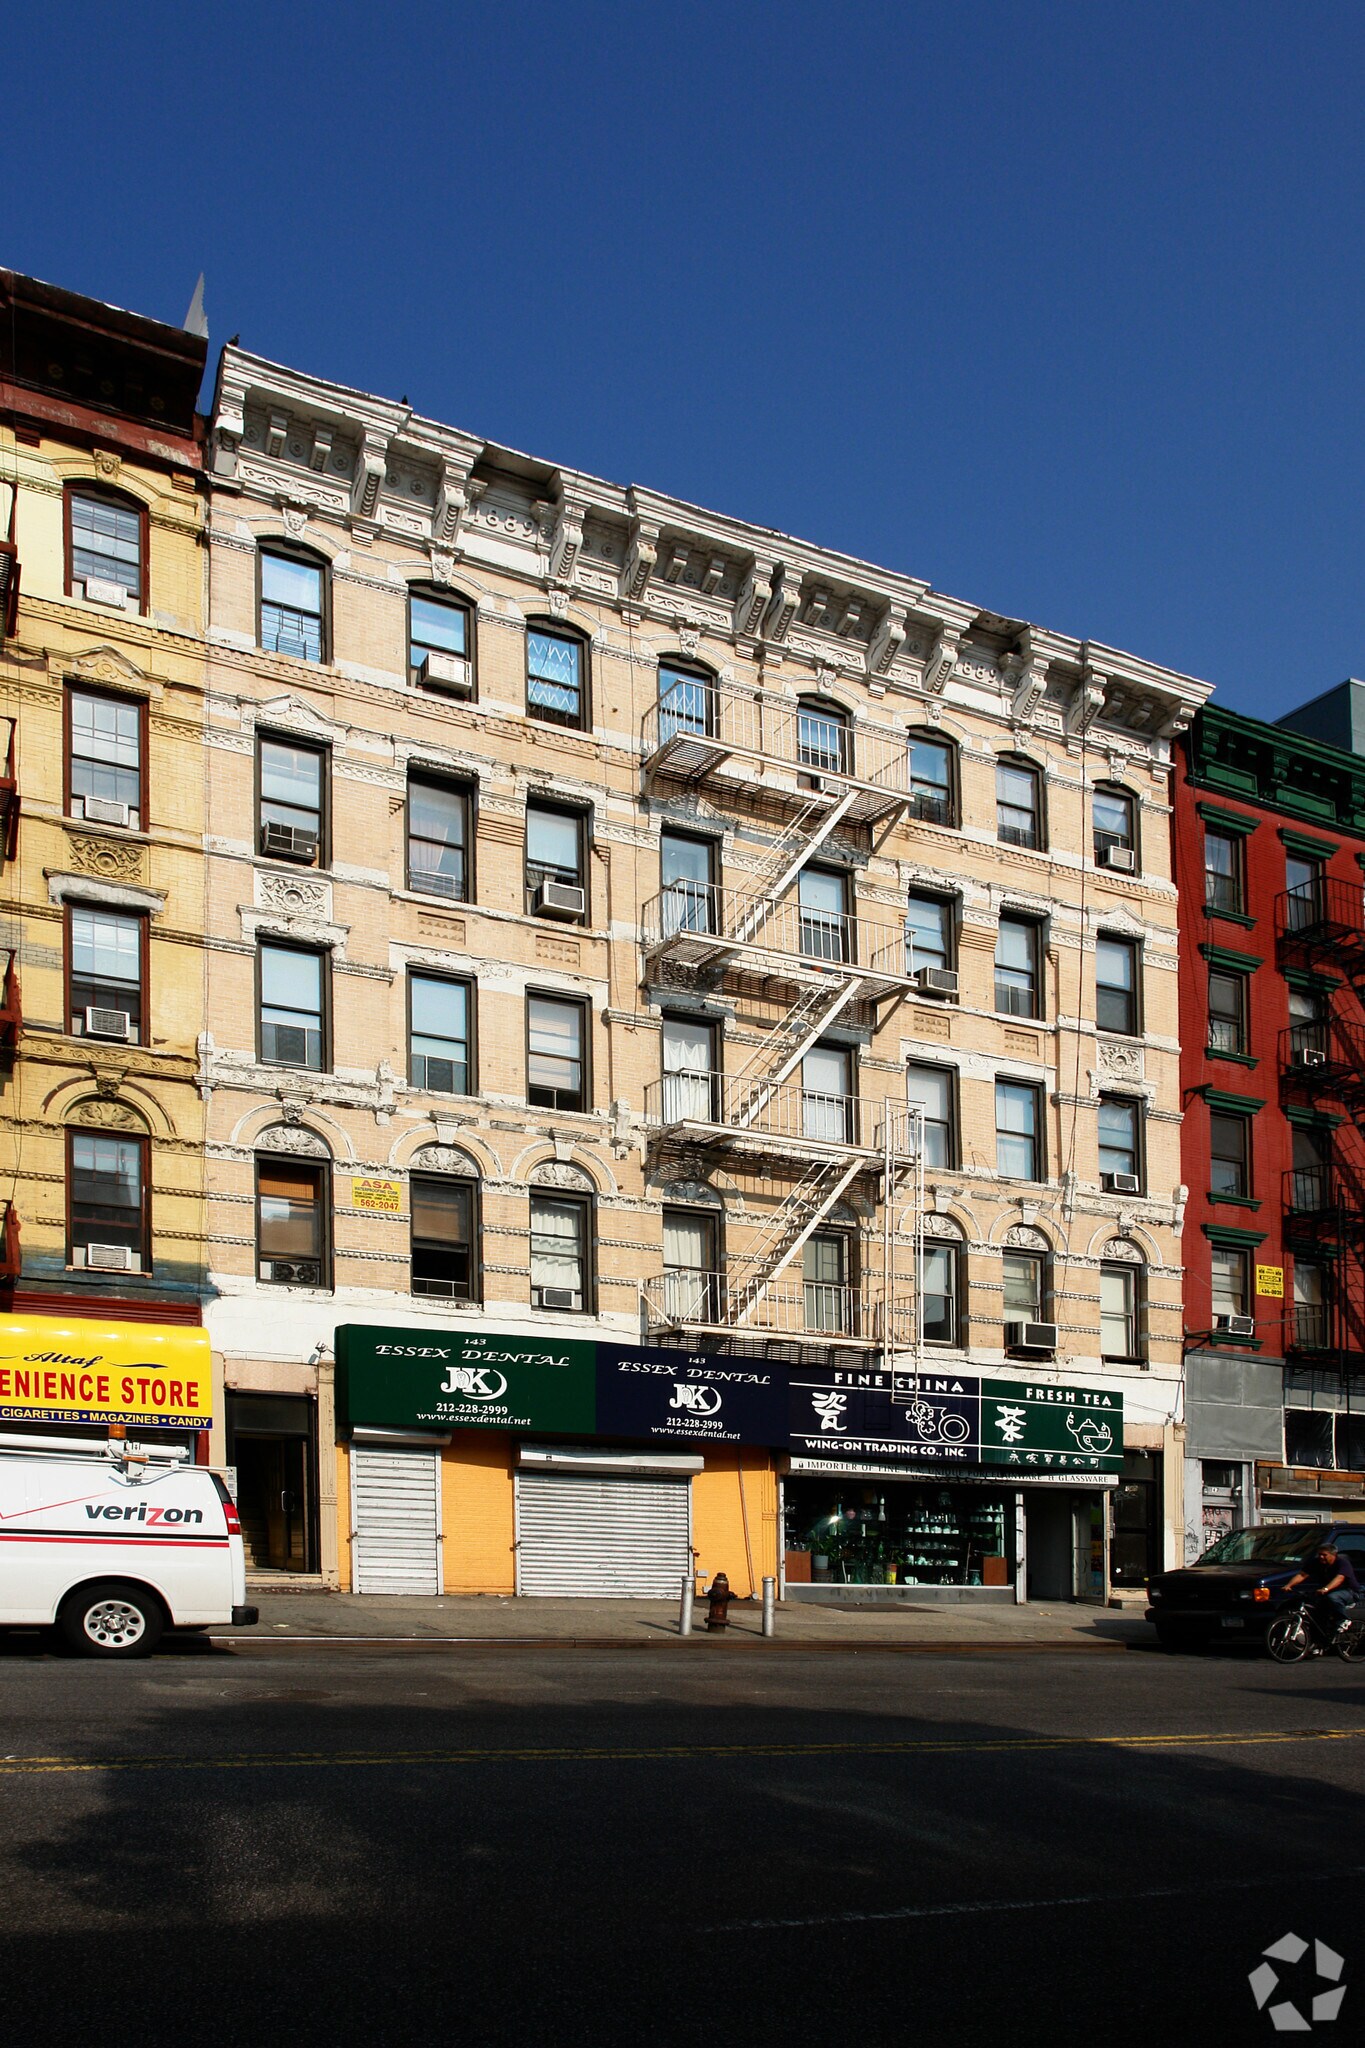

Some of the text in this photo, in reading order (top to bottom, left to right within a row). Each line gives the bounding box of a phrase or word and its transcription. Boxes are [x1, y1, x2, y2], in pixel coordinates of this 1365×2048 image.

[474, 503, 534, 537] 1889
[361, 1180, 393, 1190] ASA
[361, 1199, 399, 1210] 562-2047
[464, 1338, 487, 1346] 143
[23, 1351, 103, 1369] Altaf
[375, 1344, 570, 1367] ESSEX DENTAL
[688, 1357, 706, 1365] 143
[618, 1361, 771, 1385] ESSEX DENTAL
[834, 1372, 964, 1393] FINE CHINA
[0, 1369, 199, 1408] ENIENCE STORE
[1026, 1387, 1112, 1407] FRESH TEA
[1, 1407, 209, 1428] CIGARETTES MAGAZINES CANDY
[436, 1402, 508, 1415] 212-228-2999
[811, 1391, 848, 1431] 瓷
[416, 1412, 532, 1426] www.essexdental.net
[666, 1416, 723, 1430] 212-228-2999
[994, 1405, 1027, 1442] 茶
[651, 1426, 741, 1440] www.essexdental.net
[805, 1439, 967, 1458] WING-ON TRADING CO., INC.
[807, 1461, 857, 1471] IMPORTER
[861, 1463, 874, 1472] OF
[878, 1464, 900, 1473] FINE
[1058, 1474, 1109, 1483] GLASSWARE
[85, 1502, 203, 1527] verizon
